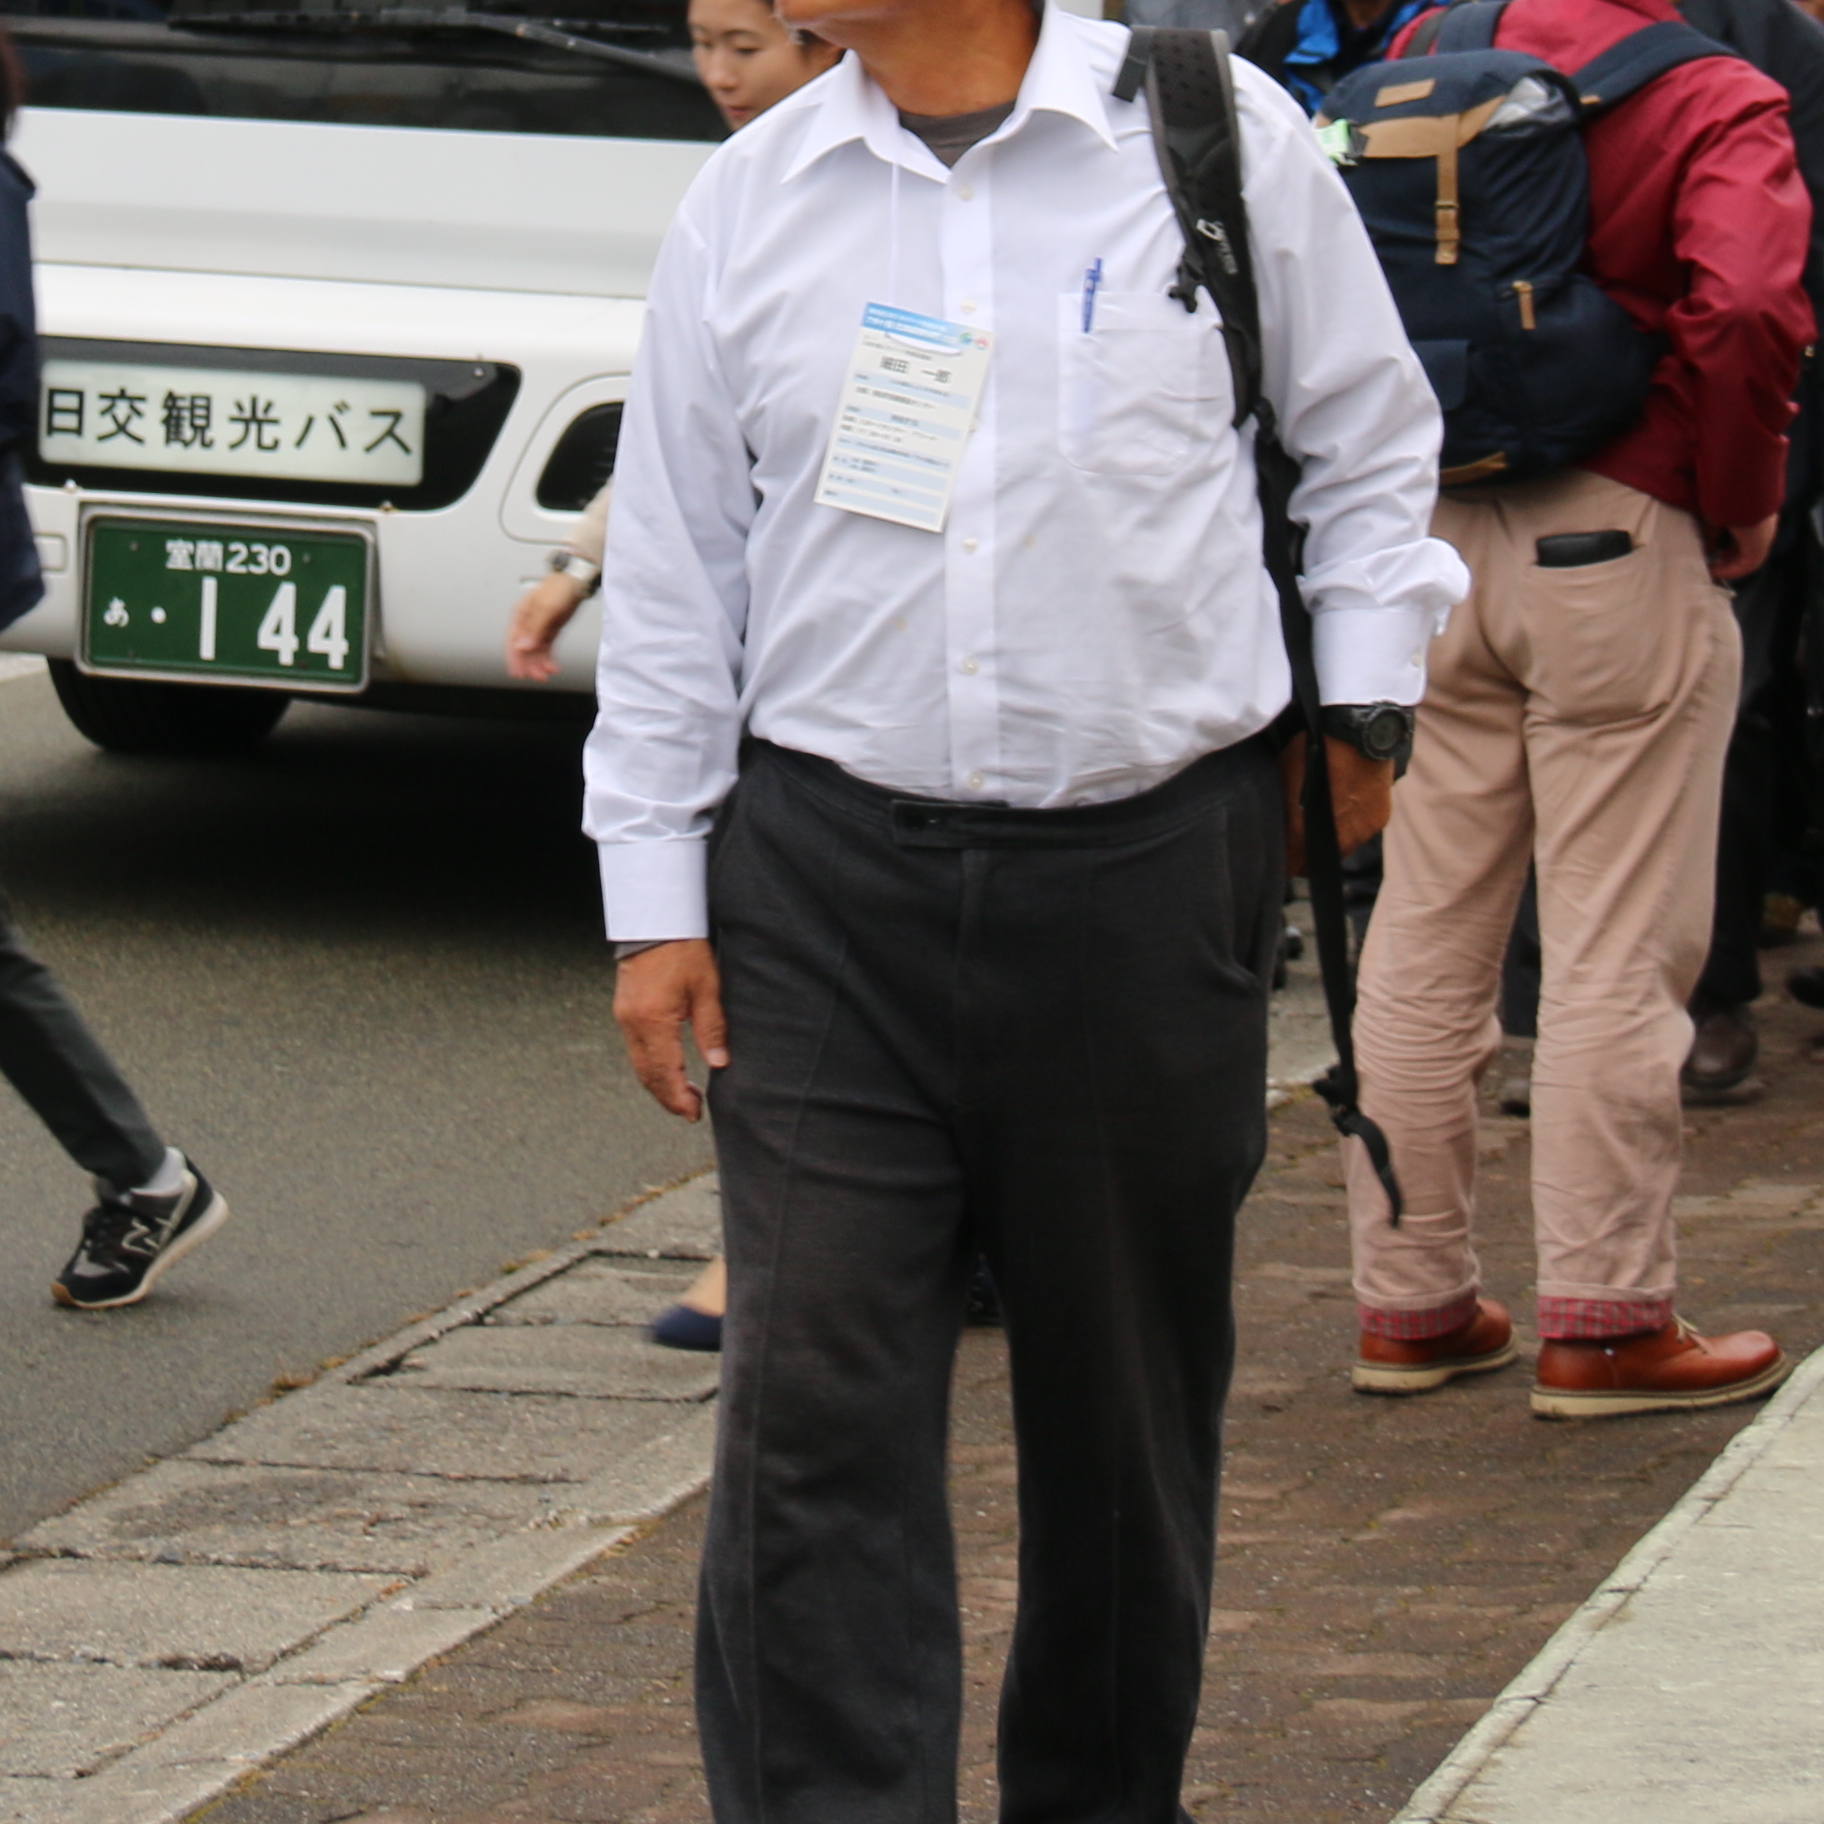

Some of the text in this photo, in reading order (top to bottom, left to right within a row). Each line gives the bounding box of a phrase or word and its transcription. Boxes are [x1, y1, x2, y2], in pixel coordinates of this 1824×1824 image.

[44, 386, 414, 457] 日交観光バス
